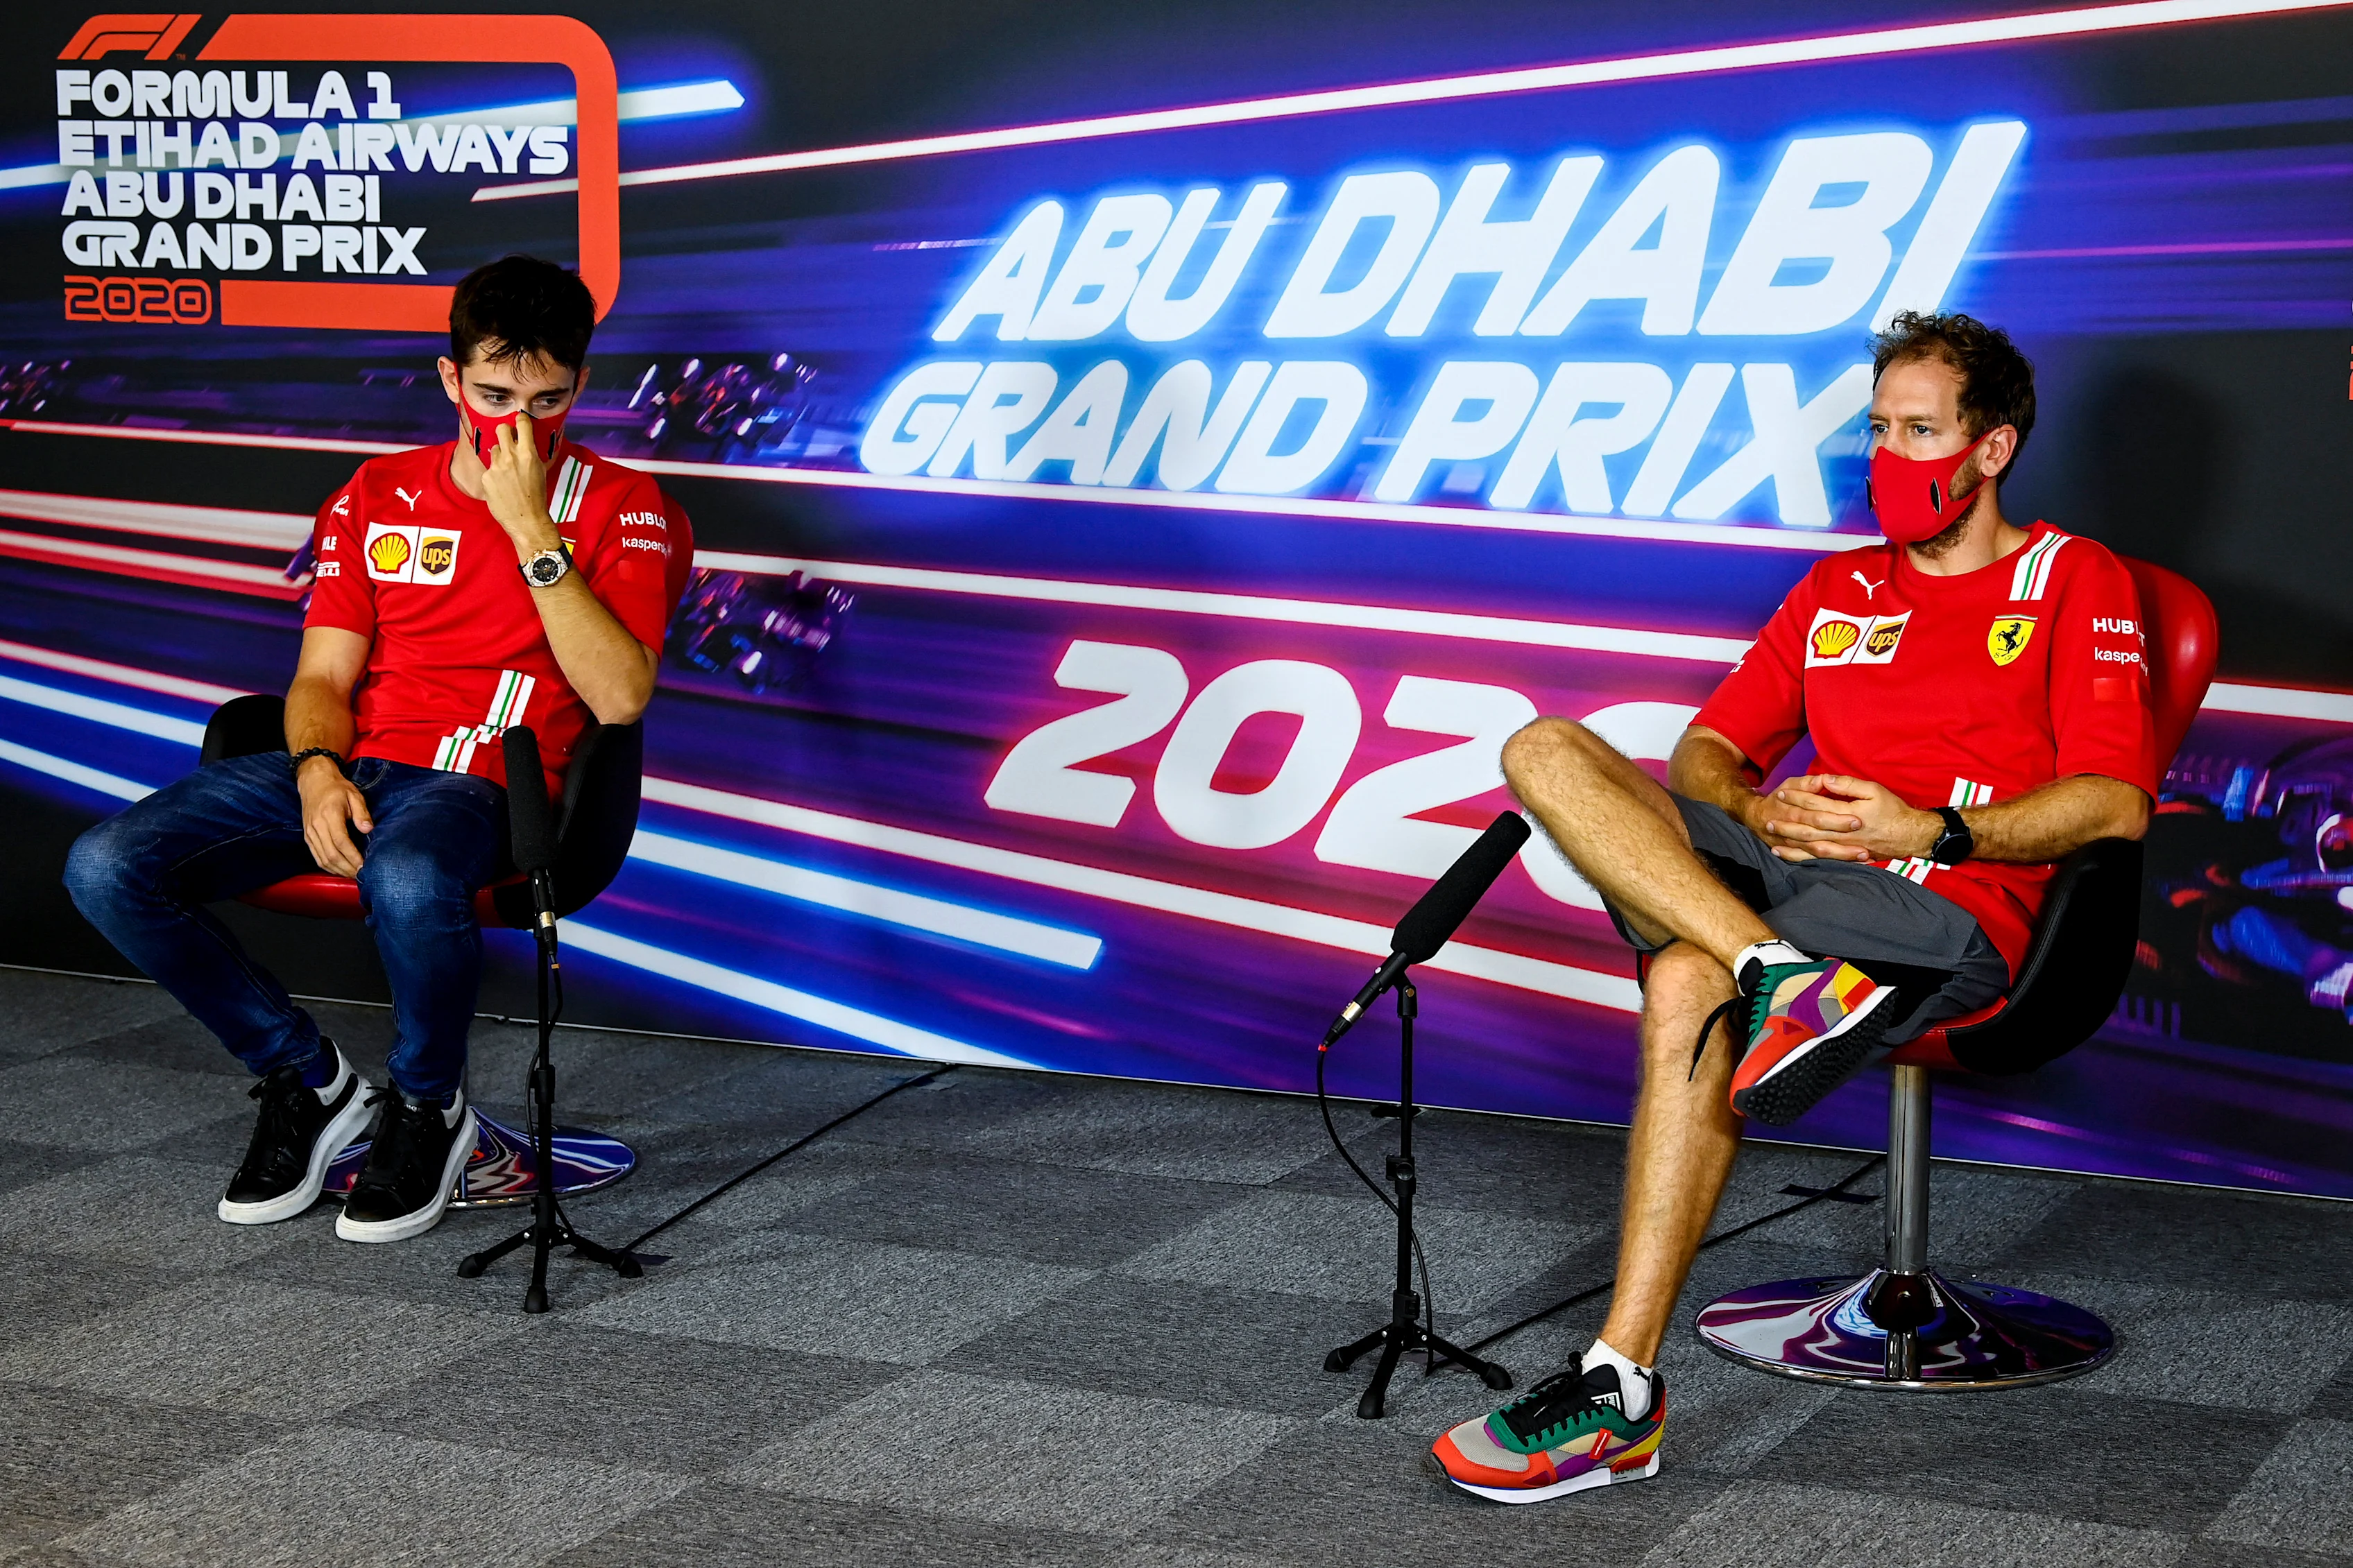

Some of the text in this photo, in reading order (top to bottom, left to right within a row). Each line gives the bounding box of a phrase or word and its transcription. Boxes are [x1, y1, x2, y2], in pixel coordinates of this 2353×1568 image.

[56, 69, 401, 119] FORMULA 1
[58, 120, 569, 175] ETIHAD AIRWAYS
[61, 170, 380, 222] ABU DHABI
[62, 221, 427, 275] GRAND PRIX
[932, 121, 2028, 343] ABU DHABI
[64, 275, 212, 325] 2020
[859, 359, 1876, 526] GRAND PRIX
[619, 512, 667, 533] HUBLO
[422, 546, 452, 571] ups
[1869, 630, 1901, 653] ups
